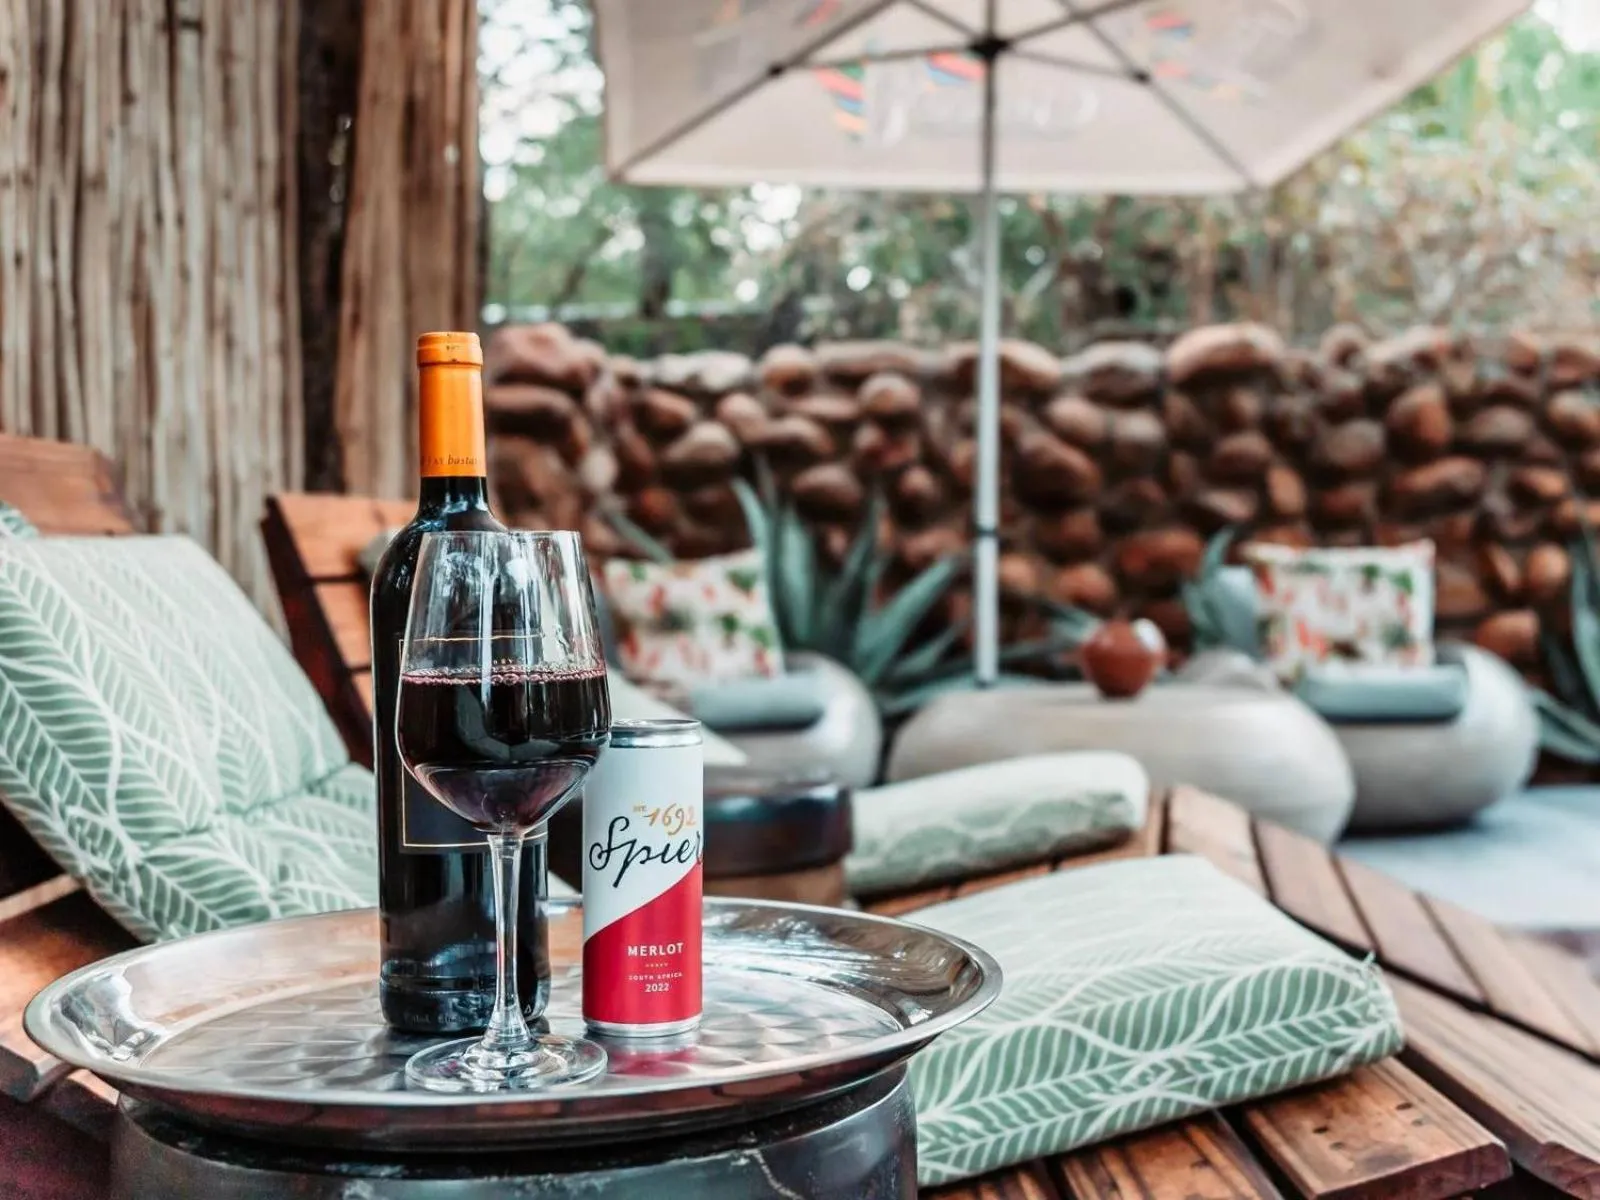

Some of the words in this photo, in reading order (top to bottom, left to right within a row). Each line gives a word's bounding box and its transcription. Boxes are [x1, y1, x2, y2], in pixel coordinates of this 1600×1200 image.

[642, 802, 698, 836] 1692
[627, 942, 684, 957] MERLOT
[628, 974, 654, 982] SOUTH
[656, 971, 684, 980] AFRICA
[644, 982, 670, 993] 2022
